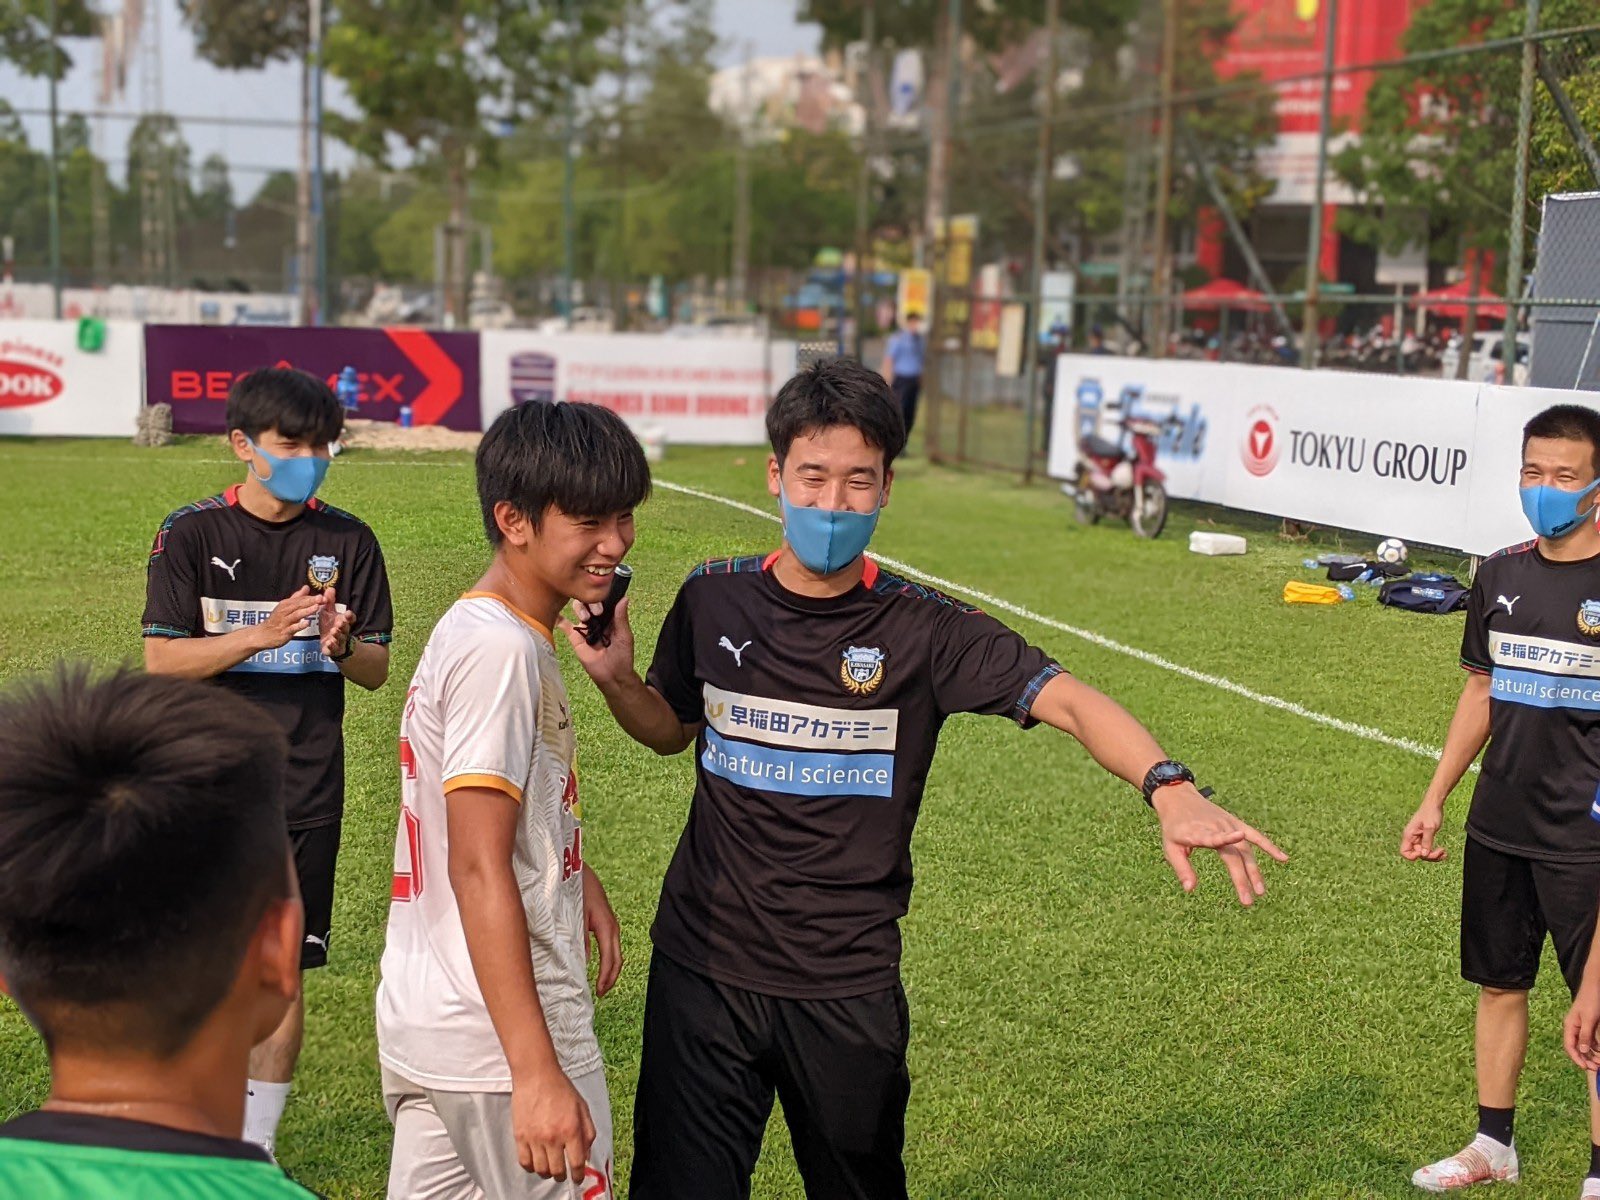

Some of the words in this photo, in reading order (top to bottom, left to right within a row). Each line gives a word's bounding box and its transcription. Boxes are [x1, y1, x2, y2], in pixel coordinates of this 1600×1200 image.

[1290, 430, 1366, 473] TOKYU
[1373, 440, 1468, 486] GROUP
[1492, 677, 1538, 697] natural
[1540, 684, 1600, 701] science
[729, 705, 888, 740] 早稲田アカデミー
[718, 750, 794, 782] natural
[801, 764, 888, 785] science
